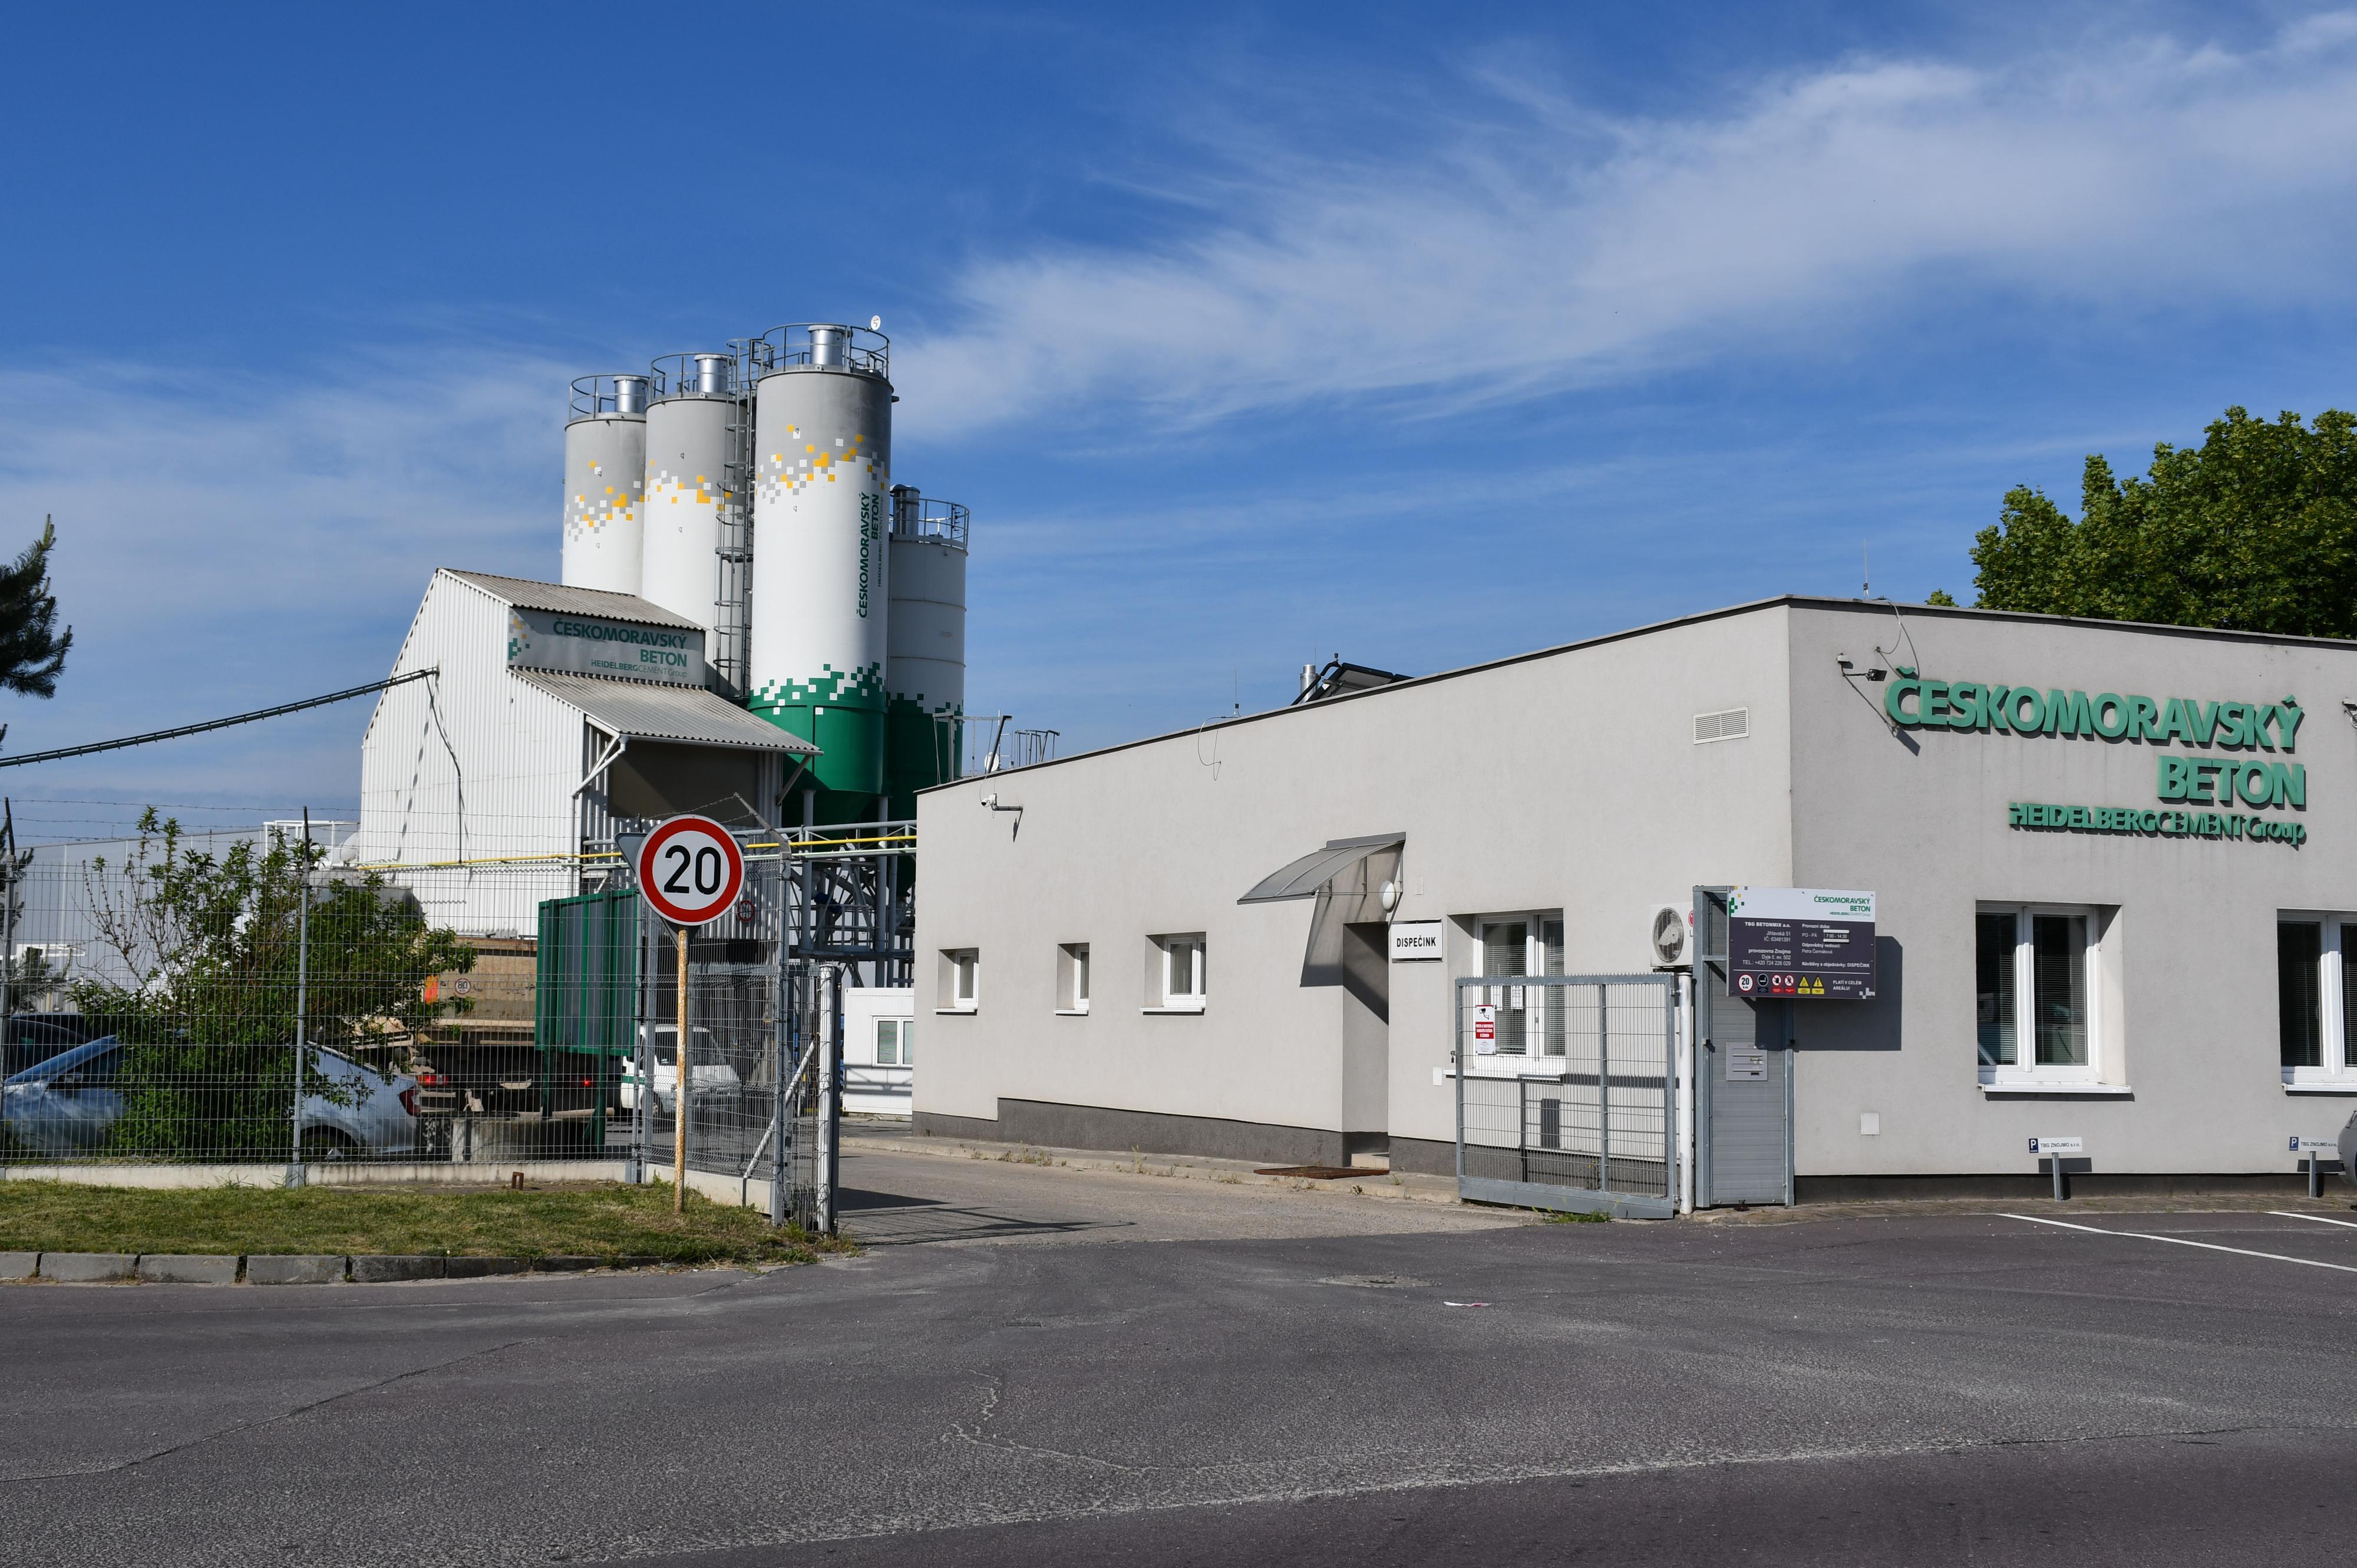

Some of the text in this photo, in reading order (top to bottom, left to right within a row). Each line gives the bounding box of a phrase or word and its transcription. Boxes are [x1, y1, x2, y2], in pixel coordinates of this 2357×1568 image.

[871, 494, 879, 540] BETON
[856, 492, 870, 618] ČESKOMORAVSKÝ
[553, 618, 687, 649] ČESKOMORAVSKÝ
[591, 659, 688, 679] HEIDELBERGCEMENT Group
[640, 649, 688, 667] BETON
[1886, 665, 2303, 748] ČESKOMORAVSKÝ
[2157, 755, 2305, 806] BETON
[2009, 803, 2305, 846] HEIDELBERGCEMENT Group
[664, 844, 721, 895] 20
[1814, 895, 1870, 905] ČESKOMORAVSKÝ
[1397, 935, 1436, 948] DISPEČINK
[457, 981, 468, 989] 80
[2030, 1140, 2036, 1149] P
[2292, 1138, 2297, 1147] P
